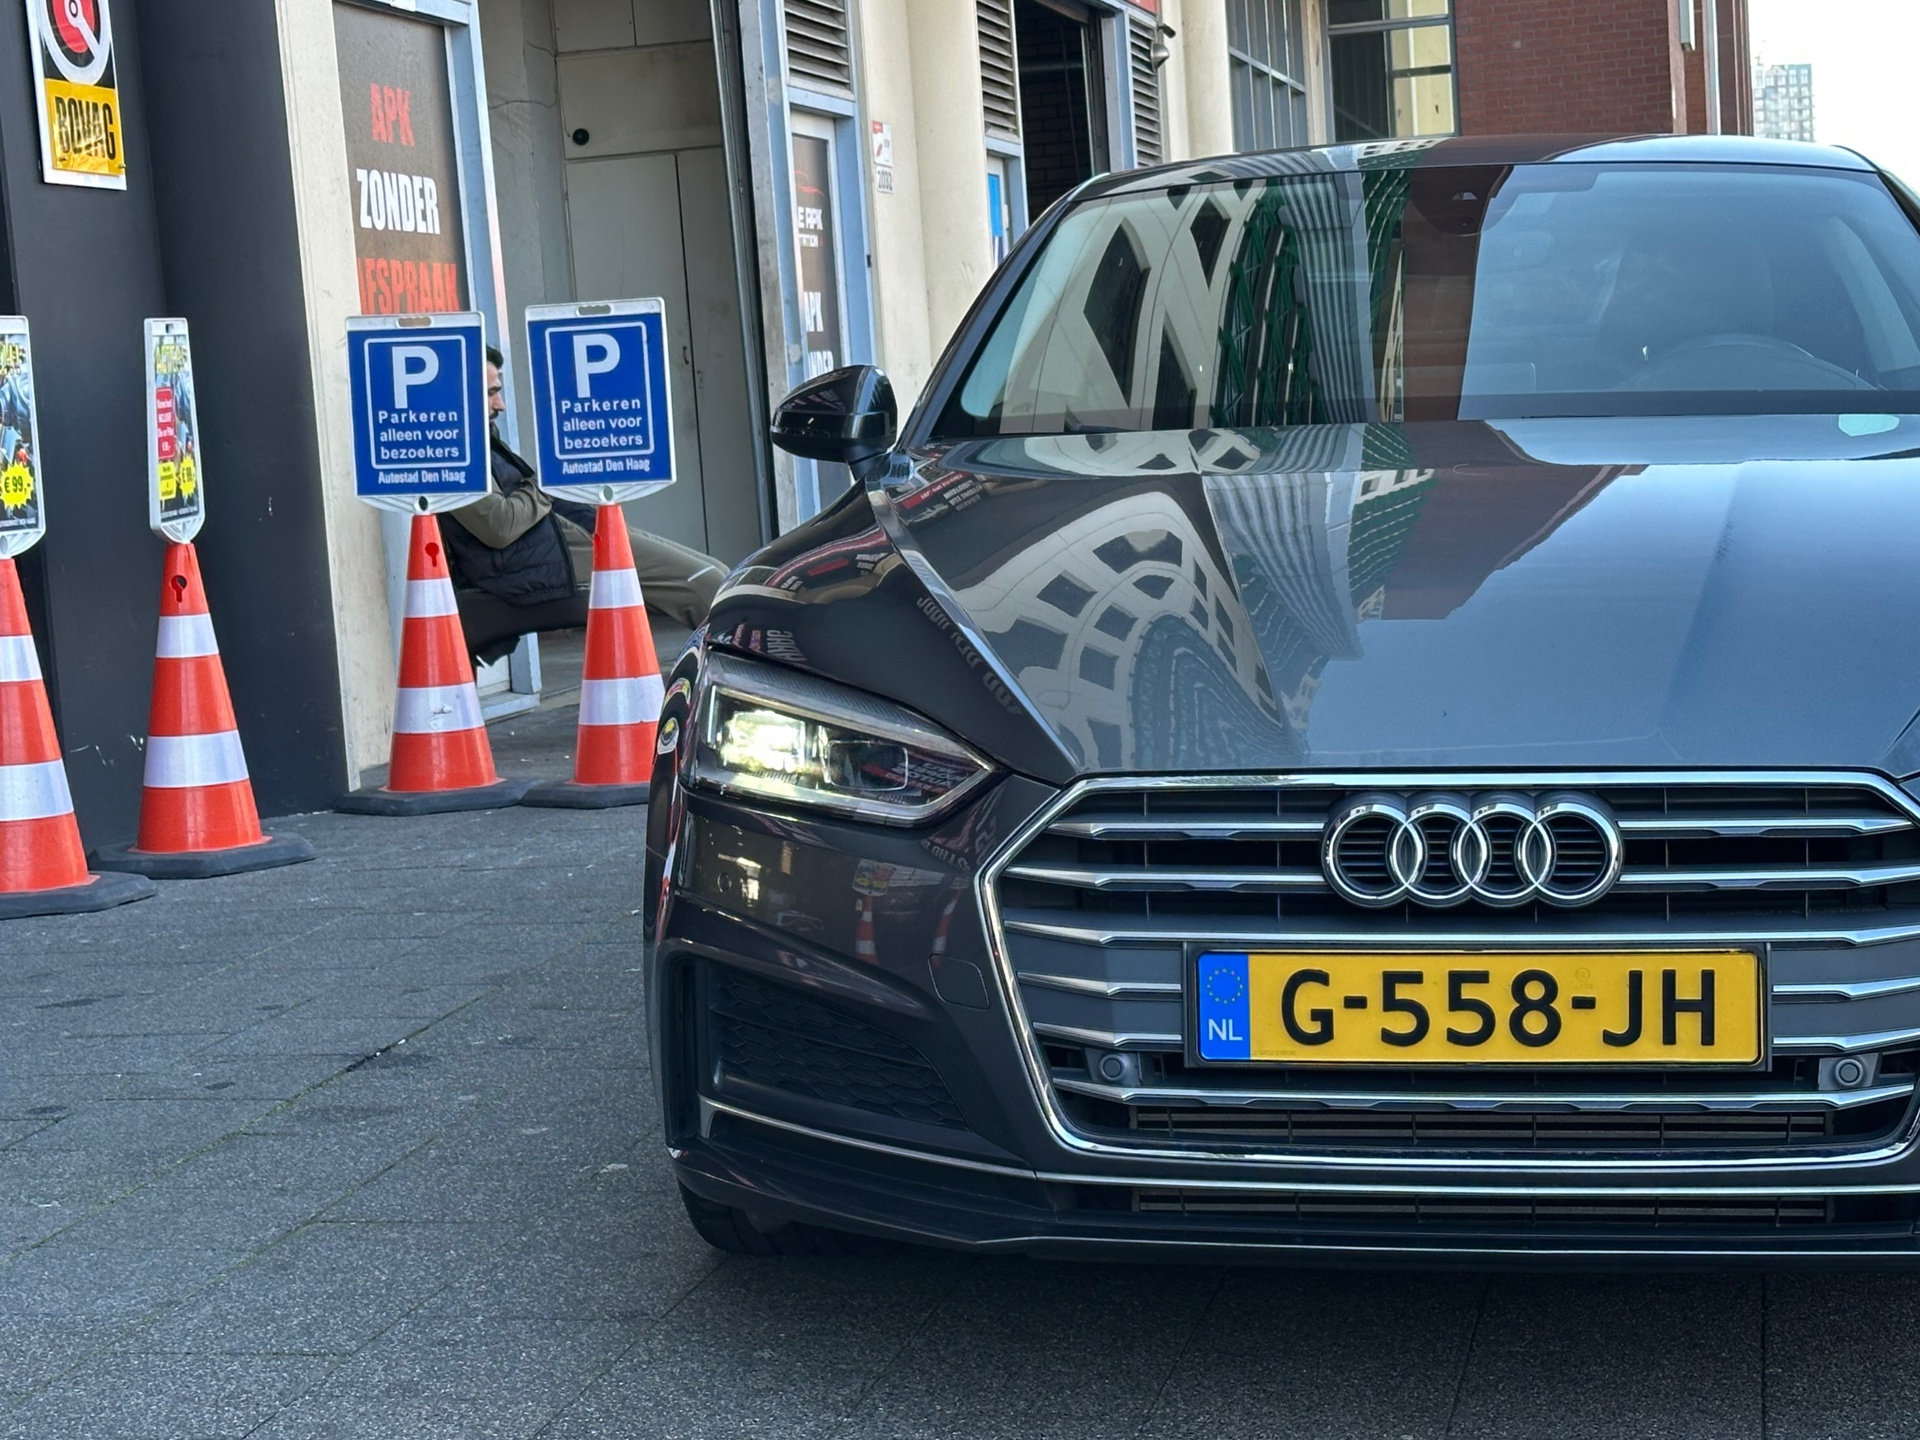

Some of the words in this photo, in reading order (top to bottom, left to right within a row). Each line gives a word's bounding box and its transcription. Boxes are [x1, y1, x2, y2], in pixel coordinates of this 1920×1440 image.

[369, 82, 416, 147] APK
[54, 96, 117, 161] BOVAG
[356, 168, 441, 235] ZONDER
[573, 333, 620, 398] P
[392, 346, 439, 409] P
[561, 399, 641, 414] Parkeren
[378, 409, 459, 424] Parkeren
[563, 419, 605, 432] alleen
[608, 416, 642, 429] voor
[379, 428, 422, 442] alleen
[425, 429, 459, 440] voor
[564, 433, 643, 450] bezoekers
[381, 445, 460, 460] bezoekers
[562, 460, 604, 475] Autostad
[605, 459, 624, 472] Den
[626, 457, 651, 472] Haag
[4, 476, 11, 493] €
[378, 471, 419, 484] Autostad
[421, 471, 440, 483] Den
[441, 469, 466, 484] Haag
[1280, 968, 1716, 1047] G-558-JH
[1208, 1018, 1244, 1041] NL
